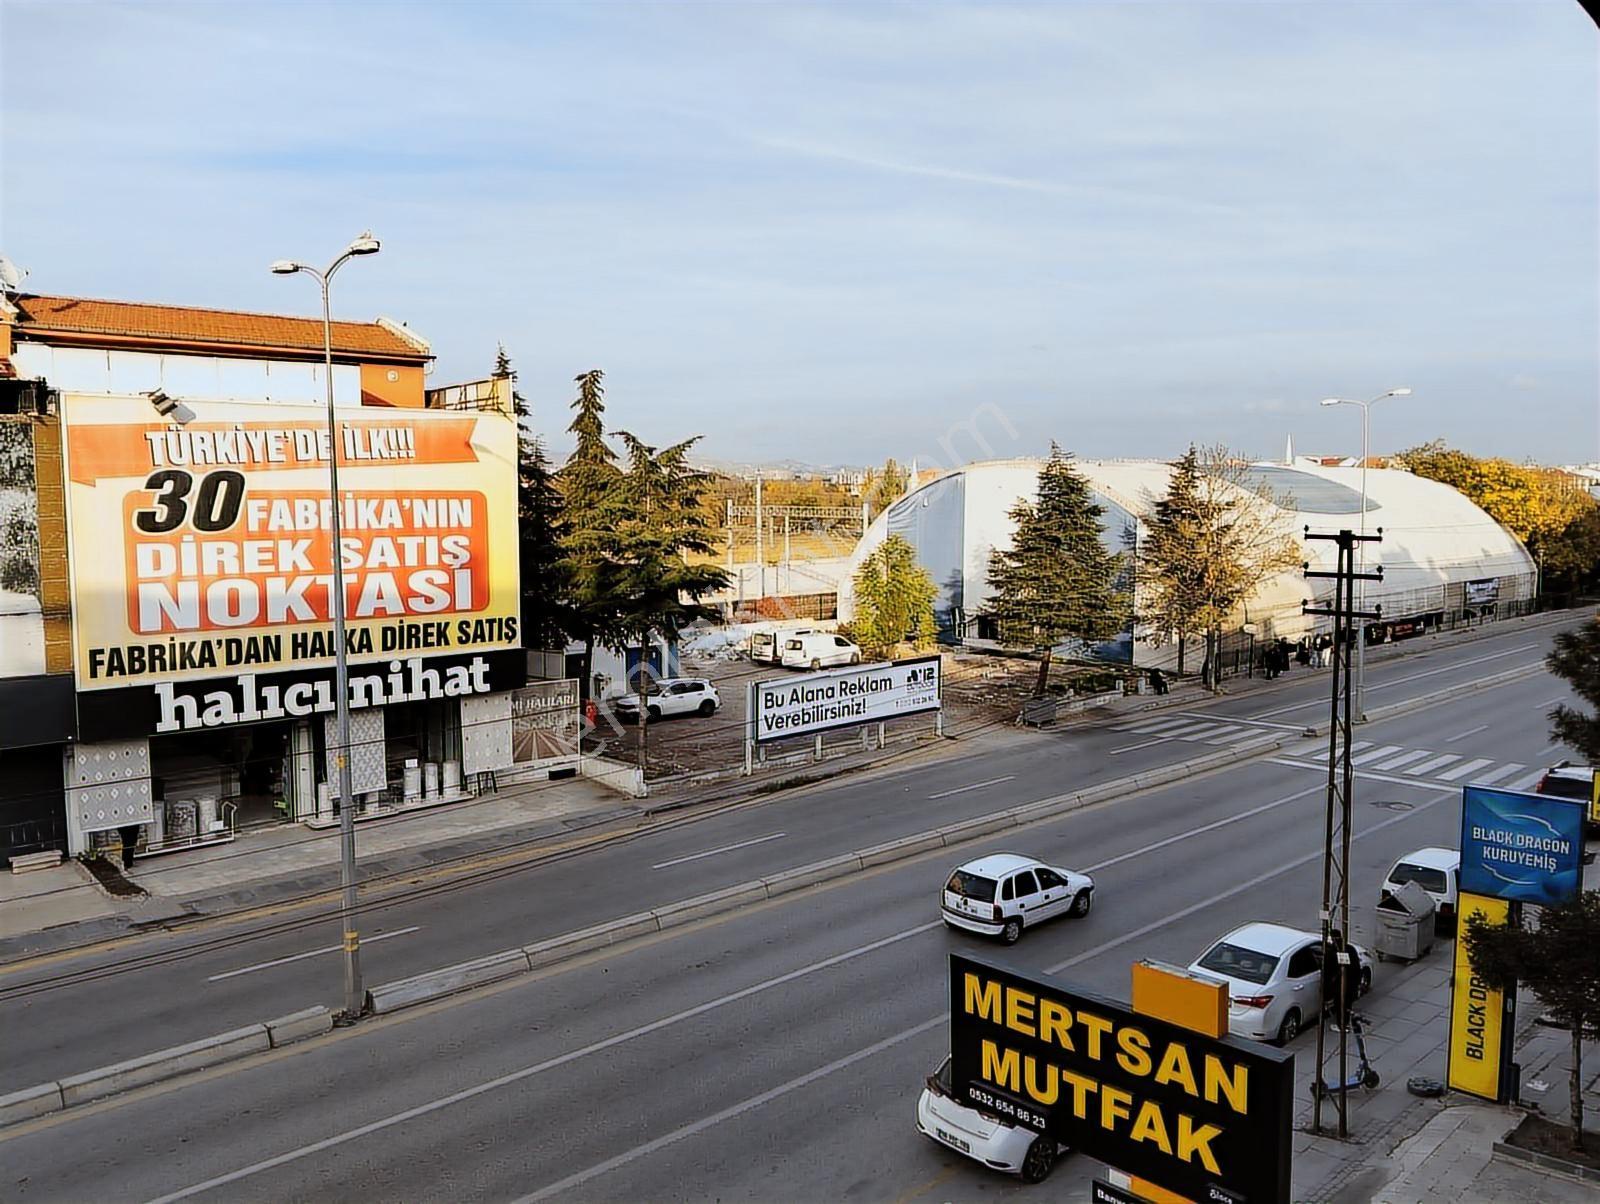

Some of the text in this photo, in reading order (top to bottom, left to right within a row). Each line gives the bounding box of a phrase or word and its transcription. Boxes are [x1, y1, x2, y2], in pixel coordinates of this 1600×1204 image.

[144, 423, 416, 467] TÜRKİYE'DE İLK!!!
[136, 469, 246, 533] 30
[136, 535, 471, 579] DİREK SATIŞ
[89, 634, 282, 679] FABRİKA'DAN
[381, 619, 451, 652] DİREK
[457, 616, 518, 645] SATIŞ
[348, 656, 491, 710] nihat
[764, 692, 784, 709] Bu
[789, 686, 835, 706] Alana
[839, 675, 893, 695] Reklam
[764, 697, 867, 731] Verebilirsiniz!
[1473, 826, 1570, 855] BLACK DRAGON
[1482, 846, 1558, 873] KURUYEMİŞ
[964, 972, 1248, 1115] MERTSAN
[1465, 1003, 1486, 1061] BLACK
[969, 1087, 994, 1107] 0532
[1032, 1115, 1046, 1129] 23
[981, 1038, 1223, 1177] MUTFAK
